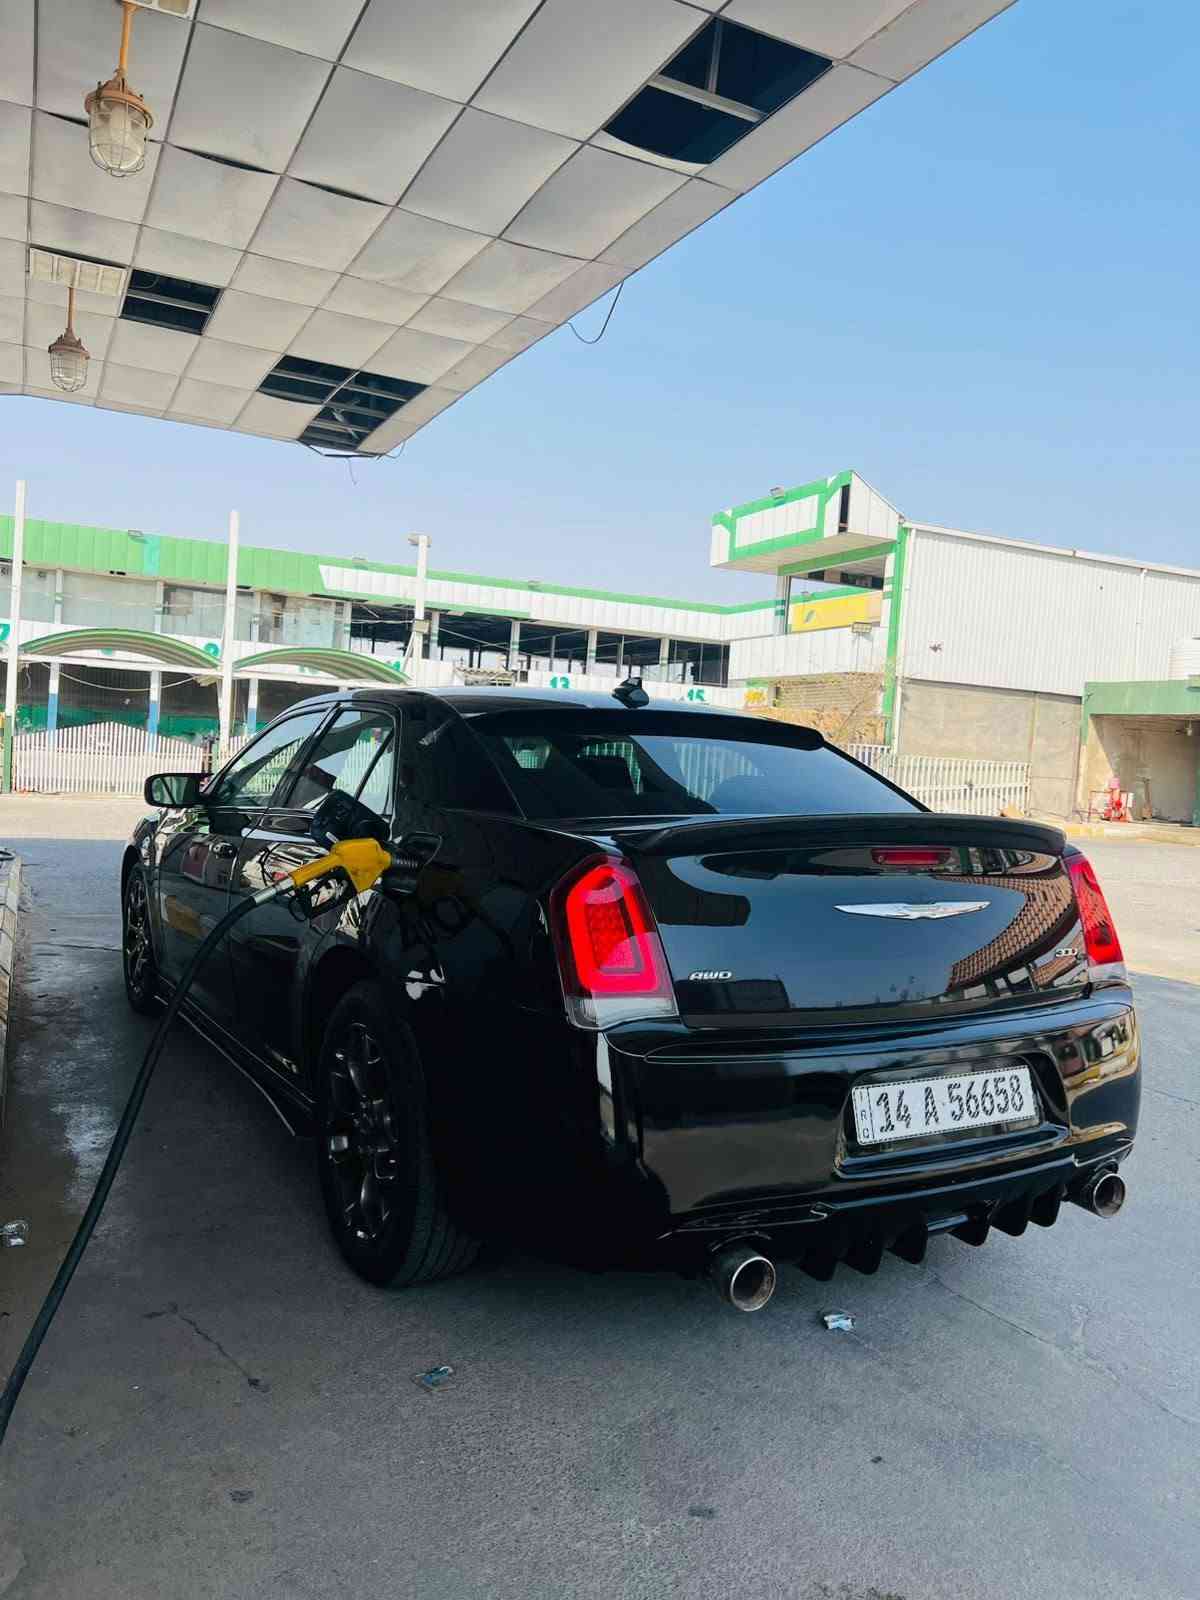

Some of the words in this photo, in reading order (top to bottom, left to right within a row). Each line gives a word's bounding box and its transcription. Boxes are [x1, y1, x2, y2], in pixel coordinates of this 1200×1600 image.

[689, 971, 732, 981] AWD
[876, 1088, 912, 1133] 14
[924, 1086, 939, 1126] A
[947, 1075, 1024, 1121] 56658
